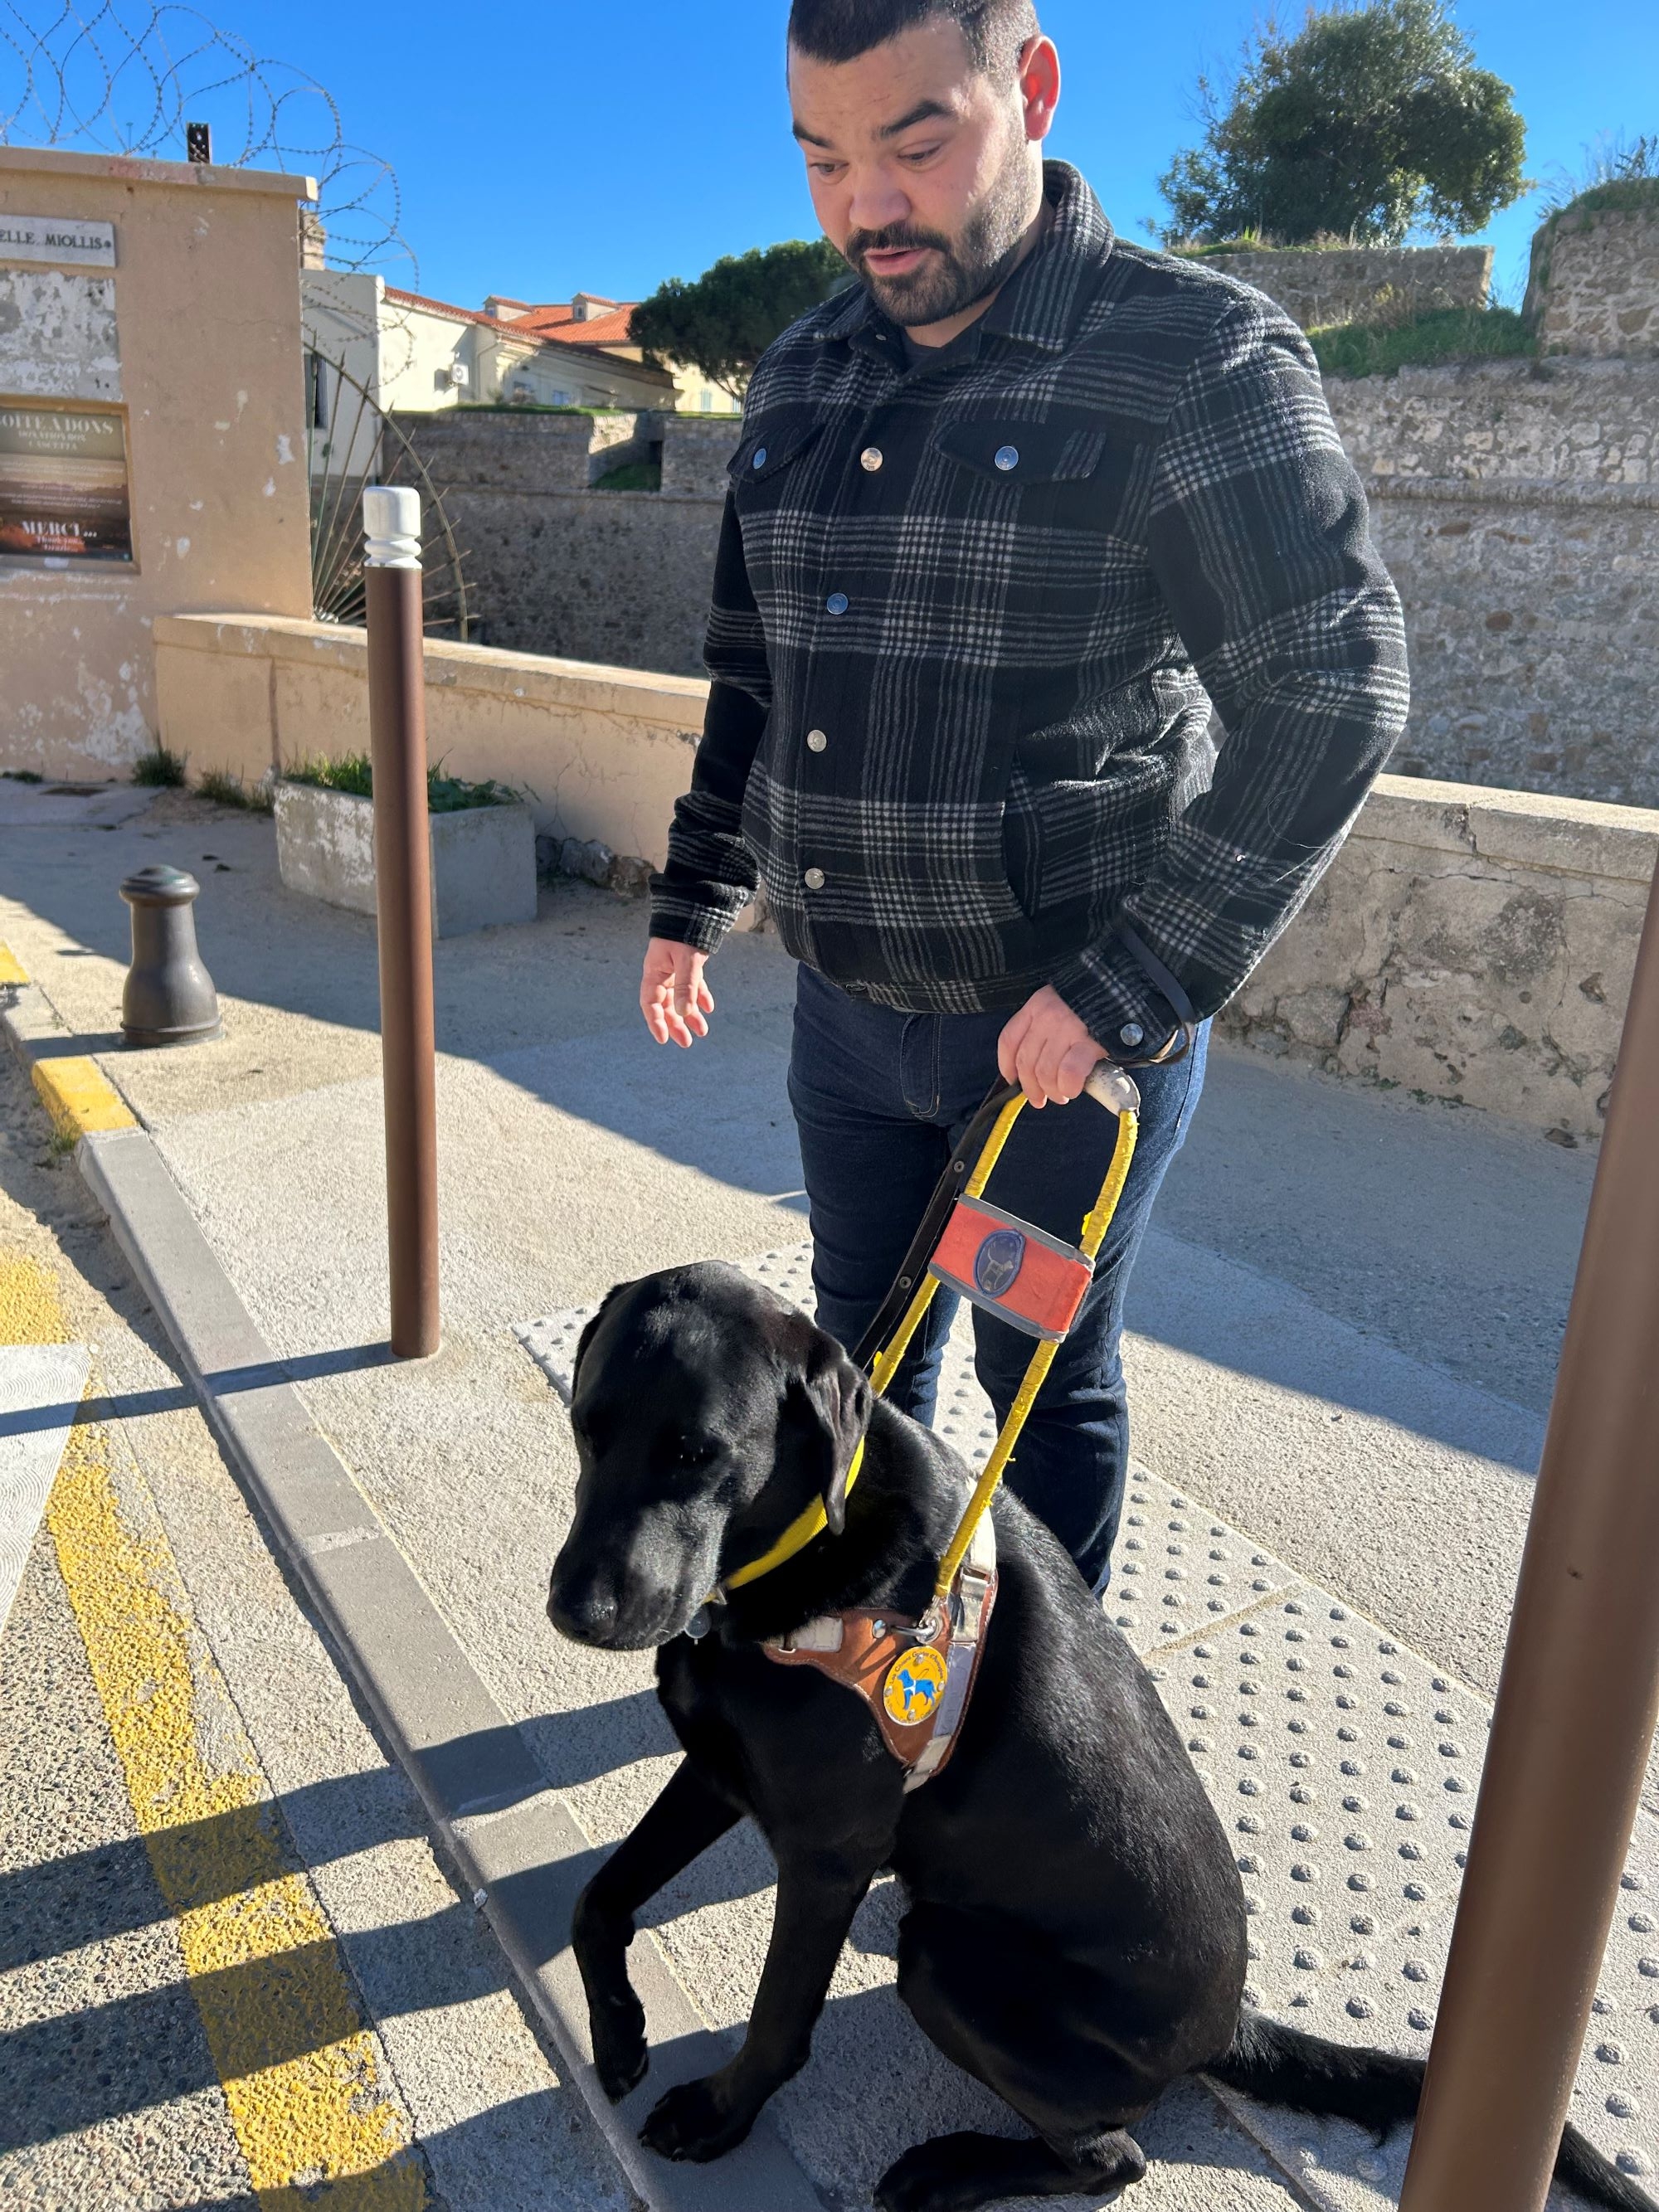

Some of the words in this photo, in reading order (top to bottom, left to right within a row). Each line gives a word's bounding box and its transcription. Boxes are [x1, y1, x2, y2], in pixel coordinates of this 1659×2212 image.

[45, 233, 102, 249] MIOLLIS
[0, 415, 47, 430] OITE
[65, 417, 114, 434] DONS
